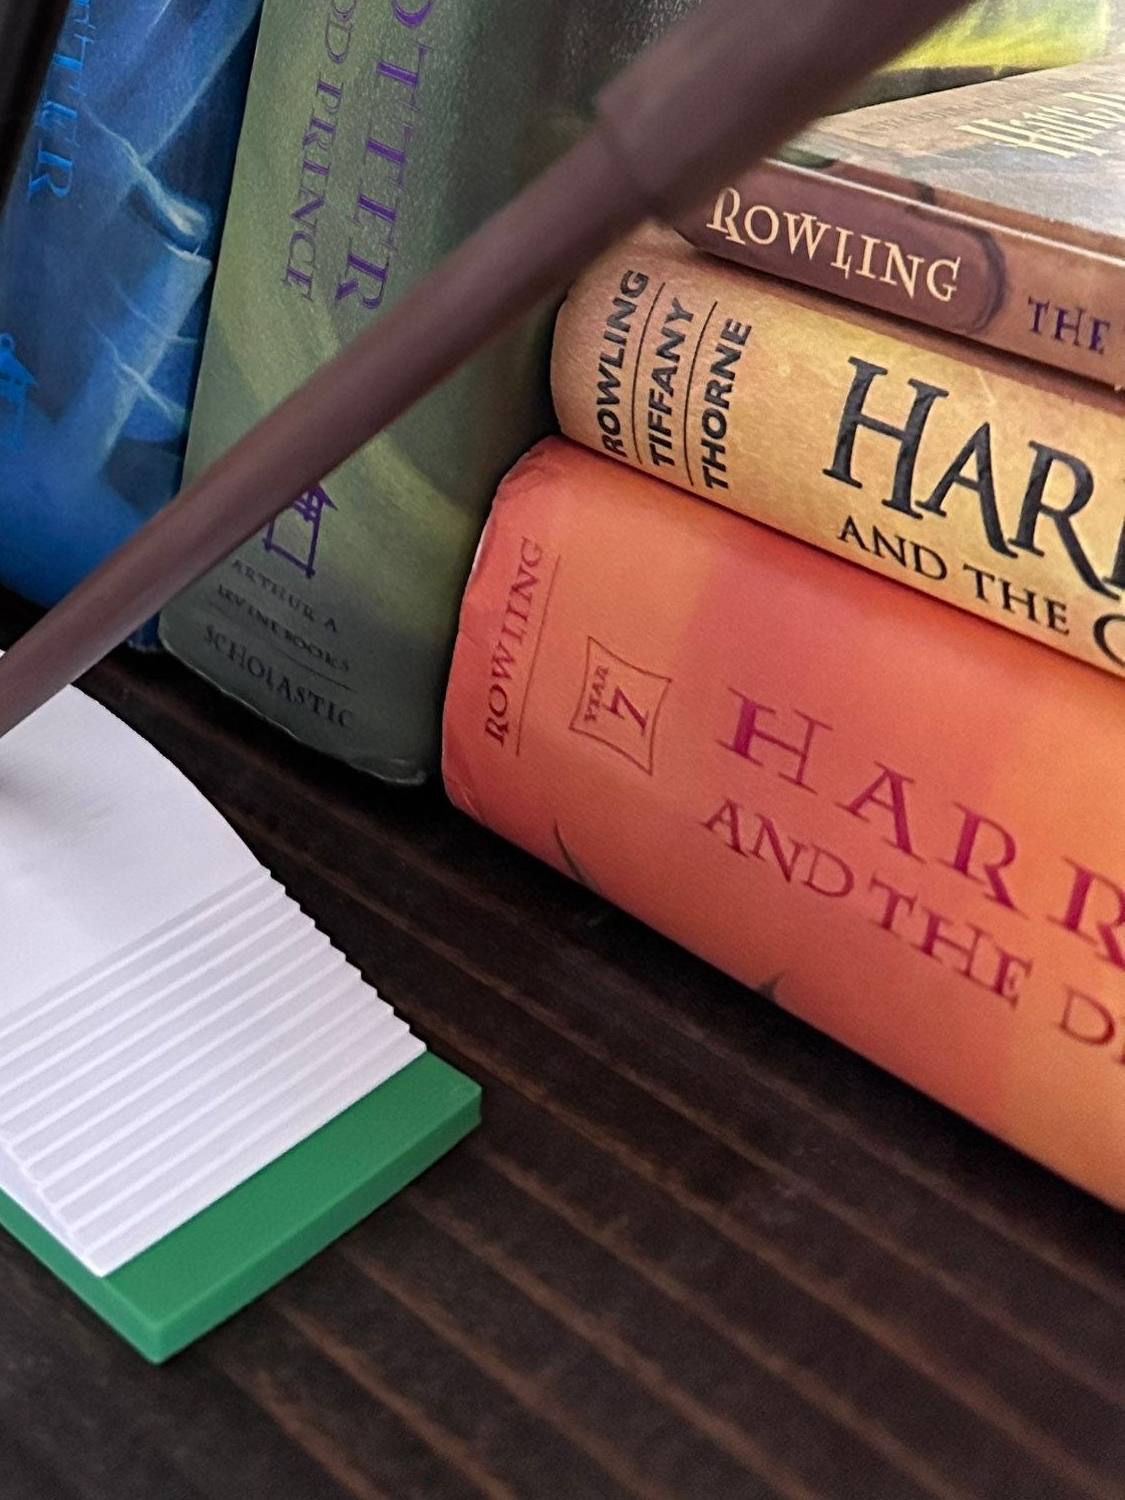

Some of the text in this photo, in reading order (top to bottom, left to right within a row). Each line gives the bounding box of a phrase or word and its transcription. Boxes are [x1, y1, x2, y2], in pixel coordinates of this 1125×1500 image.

[280, 77, 345, 303] PRINCE
[706, 186, 1113, 357] ROWLING THE
[595, 268, 652, 459] ROWLING
[646, 295, 696, 469] TIFFANY
[700, 316, 753, 492] THORNE
[822, 355, 1125, 603] HAR
[230, 558, 339, 635] ARTHUR A
[483, 534, 545, 748] ROWLING
[836, 514, 1072, 637] AND THE
[202, 624, 356, 730] SCHOLASTIC
[582, 663, 610, 726] YEAR
[606, 683, 648, 738] 7
[701, 798, 1034, 1011] AND THE
[715, 686, 1125, 973] HARR
